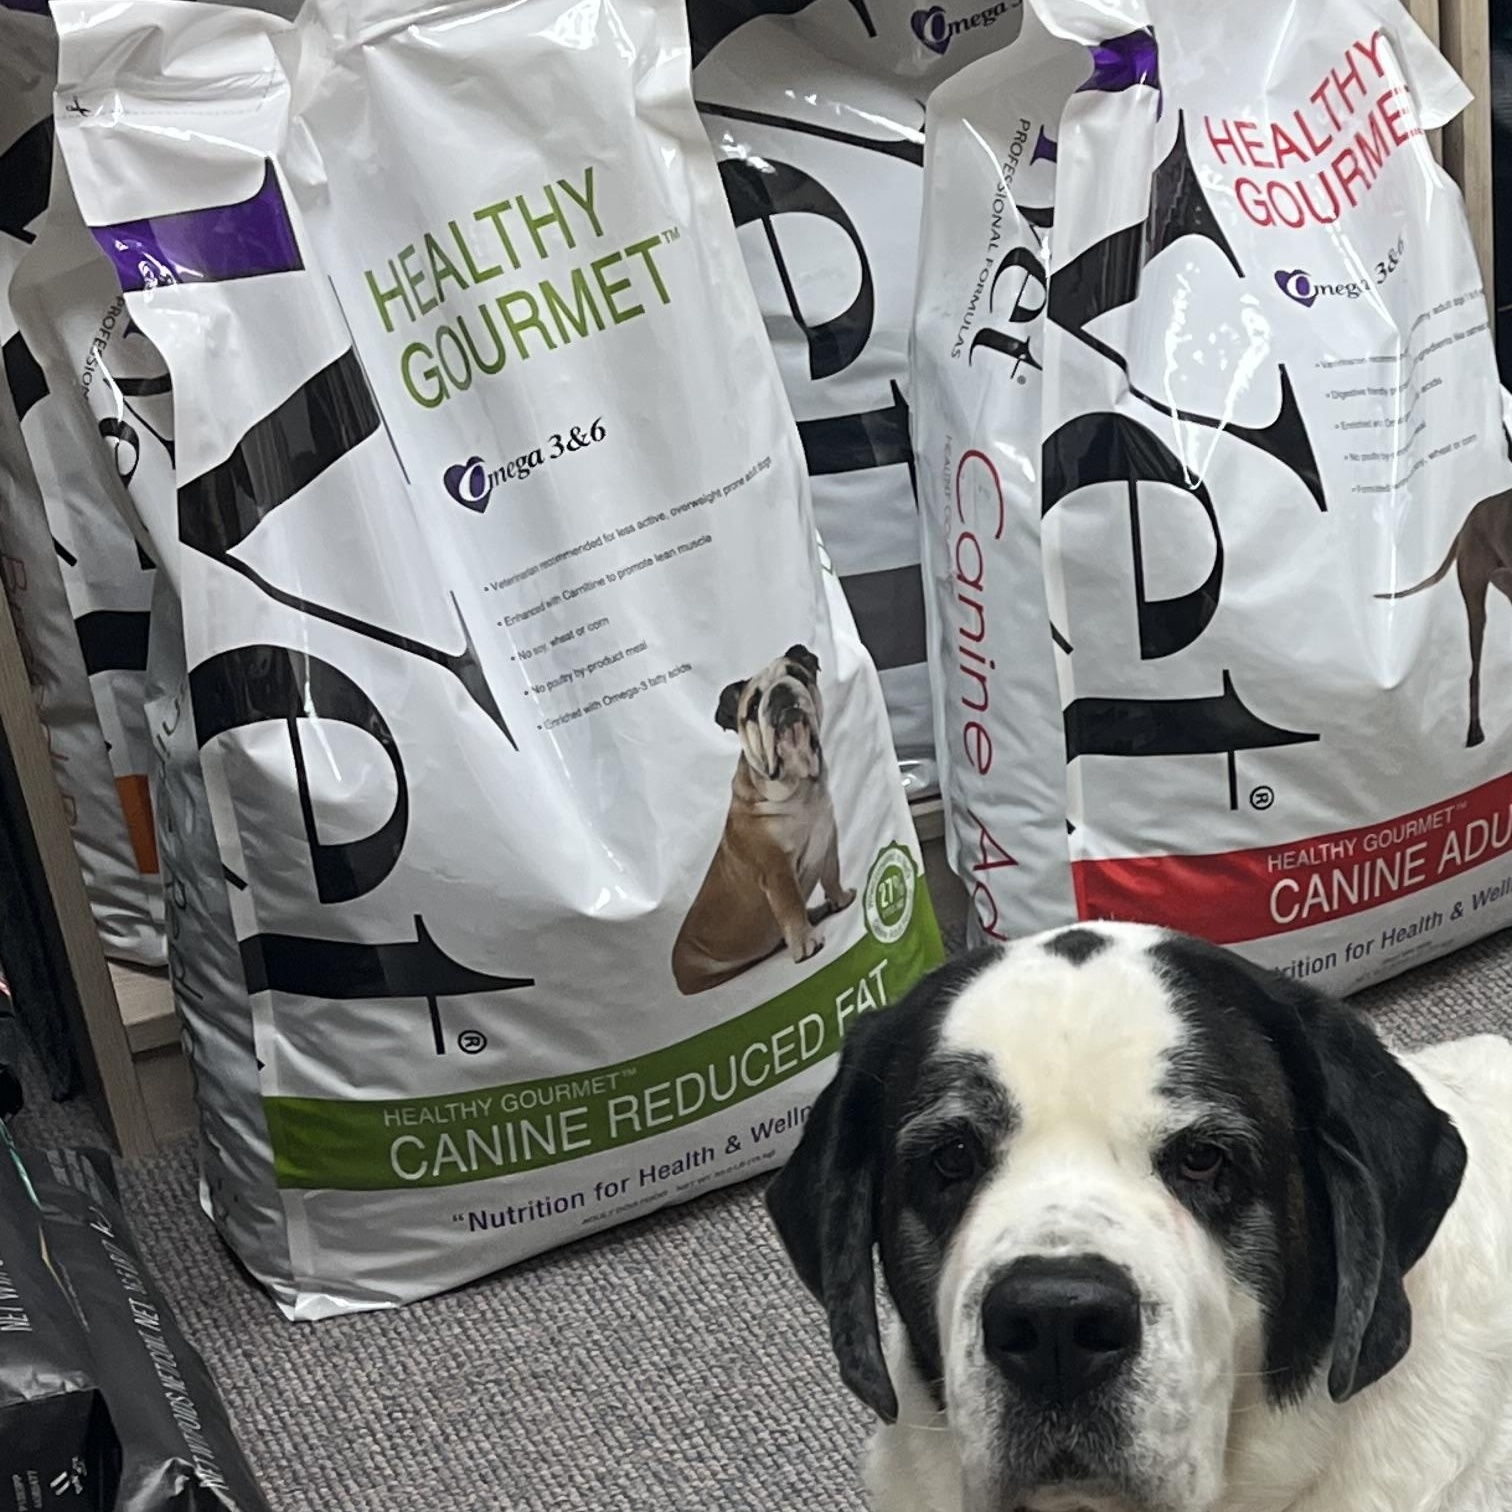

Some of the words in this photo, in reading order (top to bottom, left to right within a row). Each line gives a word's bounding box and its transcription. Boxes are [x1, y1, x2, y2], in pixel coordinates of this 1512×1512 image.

[1204, 30, 1385, 169] HEALTHY
[1234, 85, 1424, 229] GOURME
[364, 166, 604, 333] HEALTHY
[82, 295, 124, 400] PROFESSION
[950, 257, 995, 359] FORMULAS
[459, 448, 545, 502] Omega
[549, 416, 607, 459] 3&6
[602, 532, 616, 544] for
[615, 524, 636, 538] less
[670, 487, 722, 517] overweight
[504, 601, 546, 627] Enhanced
[606, 572, 617, 583] to
[617, 557, 654, 580] promote
[654, 548, 676, 563] lean
[677, 534, 713, 554] muscle
[955, 449, 1004, 776] Canine
[518, 649, 533, 661] No
[575, 626, 586, 637] or
[587, 616, 610, 633] corn
[584, 700, 602, 714] with
[602, 680, 649, 706] Omega-3
[668, 661, 693, 679] acids
[1267, 837, 1357, 873] HEALTHY
[1269, 842, 1428, 924] CANINE
[1344, 939, 1374, 964] for
[1381, 910, 1443, 950] Health
[1450, 901, 1464, 920] &
[383, 1097, 494, 1129] HEALTHY
[389, 1107, 591, 1182] CANINE
[606, 1013, 827, 1139] REDUCED
[833, 959, 890, 1039] FAT
[594, 1175, 630, 1203] for
[638, 1146, 716, 1188] Health
[724, 1134, 742, 1155] &
[750, 1103, 812, 1146] Welln
